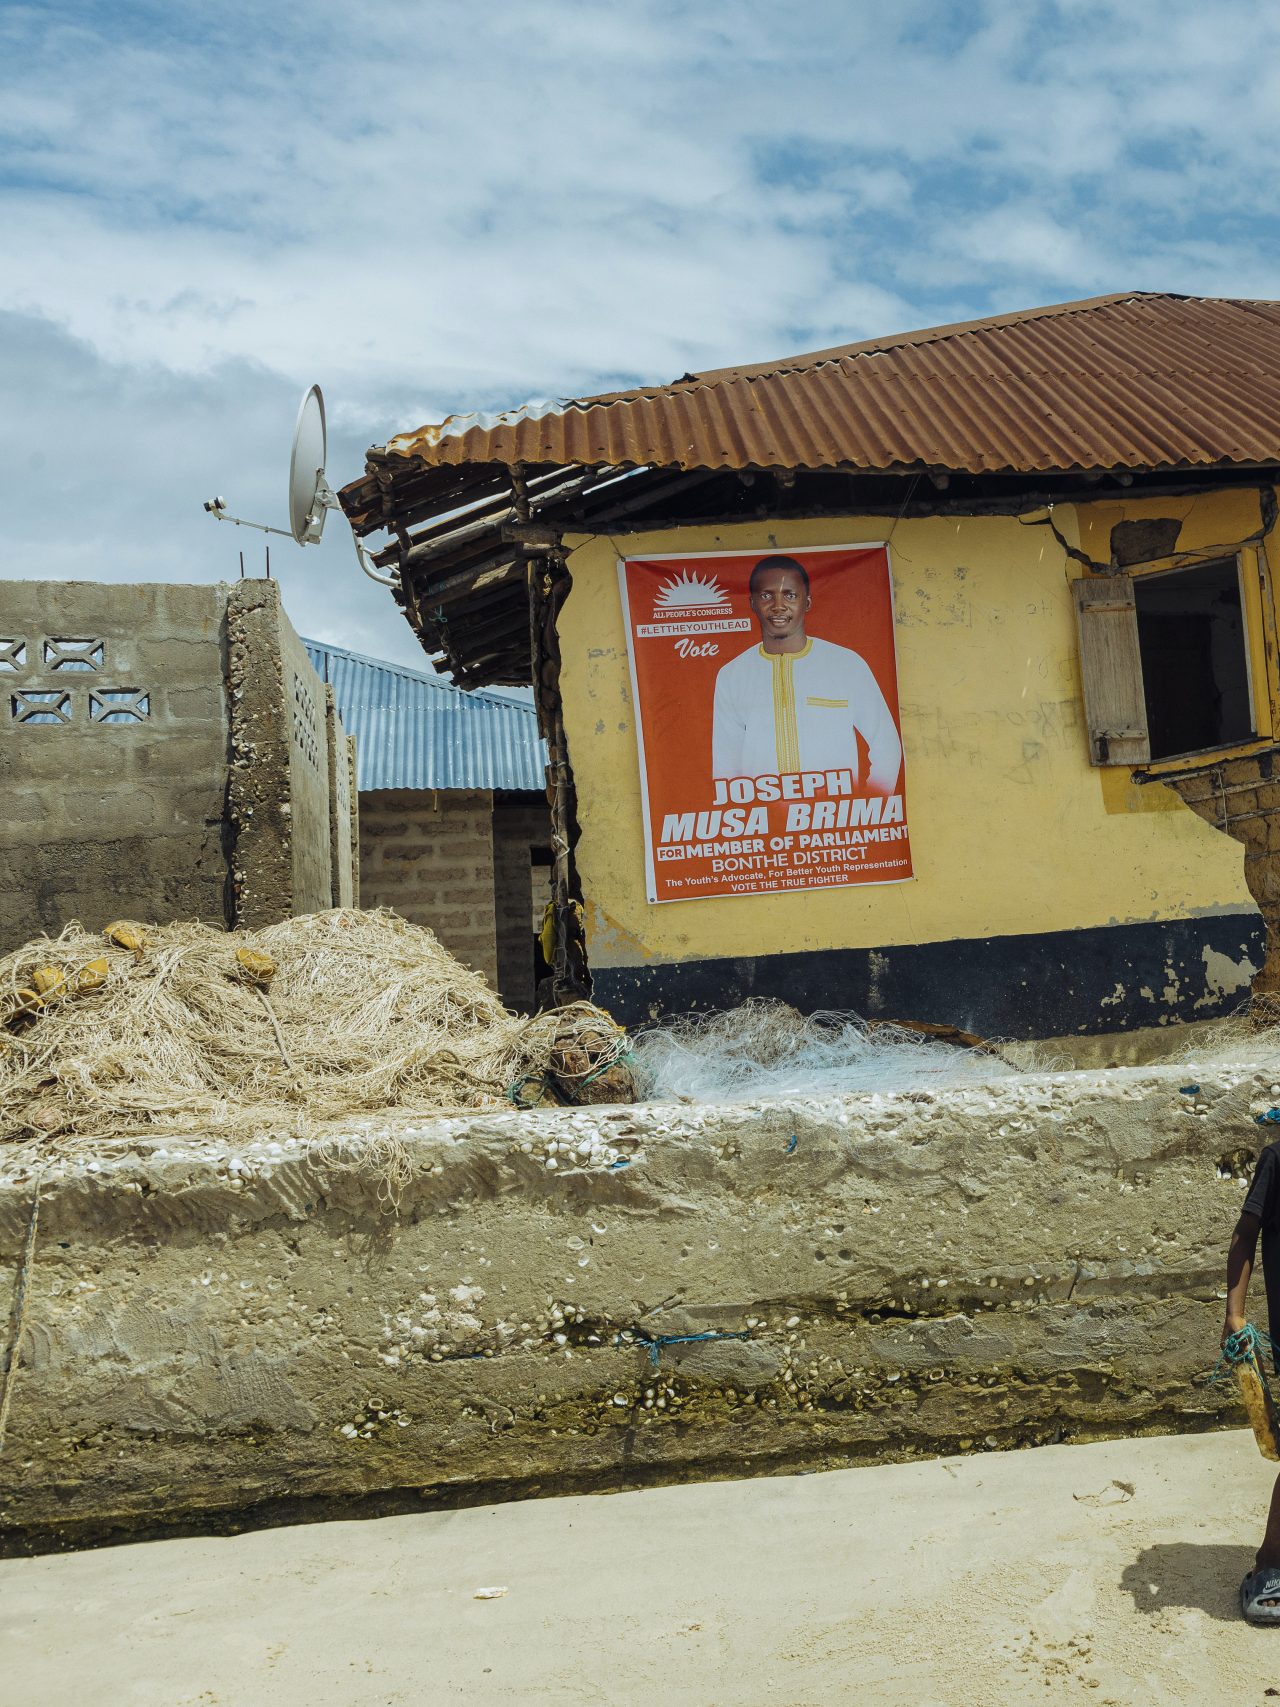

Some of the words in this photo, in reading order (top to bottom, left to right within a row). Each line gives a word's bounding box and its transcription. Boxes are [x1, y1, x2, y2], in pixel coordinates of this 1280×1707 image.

[653, 611, 666, 619] ALL
[666, 609, 696, 618] PEOPLE'S
[697, 608, 733, 617] CONGRESS
[641, 621, 749, 634] #LETTHEYOUTHLEAD
[674, 638, 719, 659] Vote
[713, 770, 852, 806] JOSEPH
[660, 807, 768, 843] MUSA
[786, 795, 904, 832] BRIMA
[660, 849, 683, 859] FOR
[687, 840, 765, 859] MEMBER
[770, 836, 794, 850] OF
[800, 824, 908, 849] PARLIAMENT
[712, 854, 788, 872] BONTHE
[793, 846, 868, 866] DISTRICT
[666, 878, 682, 888] The
[685, 876, 719, 885] Youth's
[721, 872, 766, 882] Advocate,
[768, 870, 784, 878] For
[786, 867, 812, 876] Better
[815, 864, 841, 874] Youth
[843, 858, 908, 873] Representation
[731, 882, 757, 892] VOTE
[760, 881, 778, 889] THE
[780, 878, 806, 888] TRUE
[808, 874, 849, 885] FIGHTER
